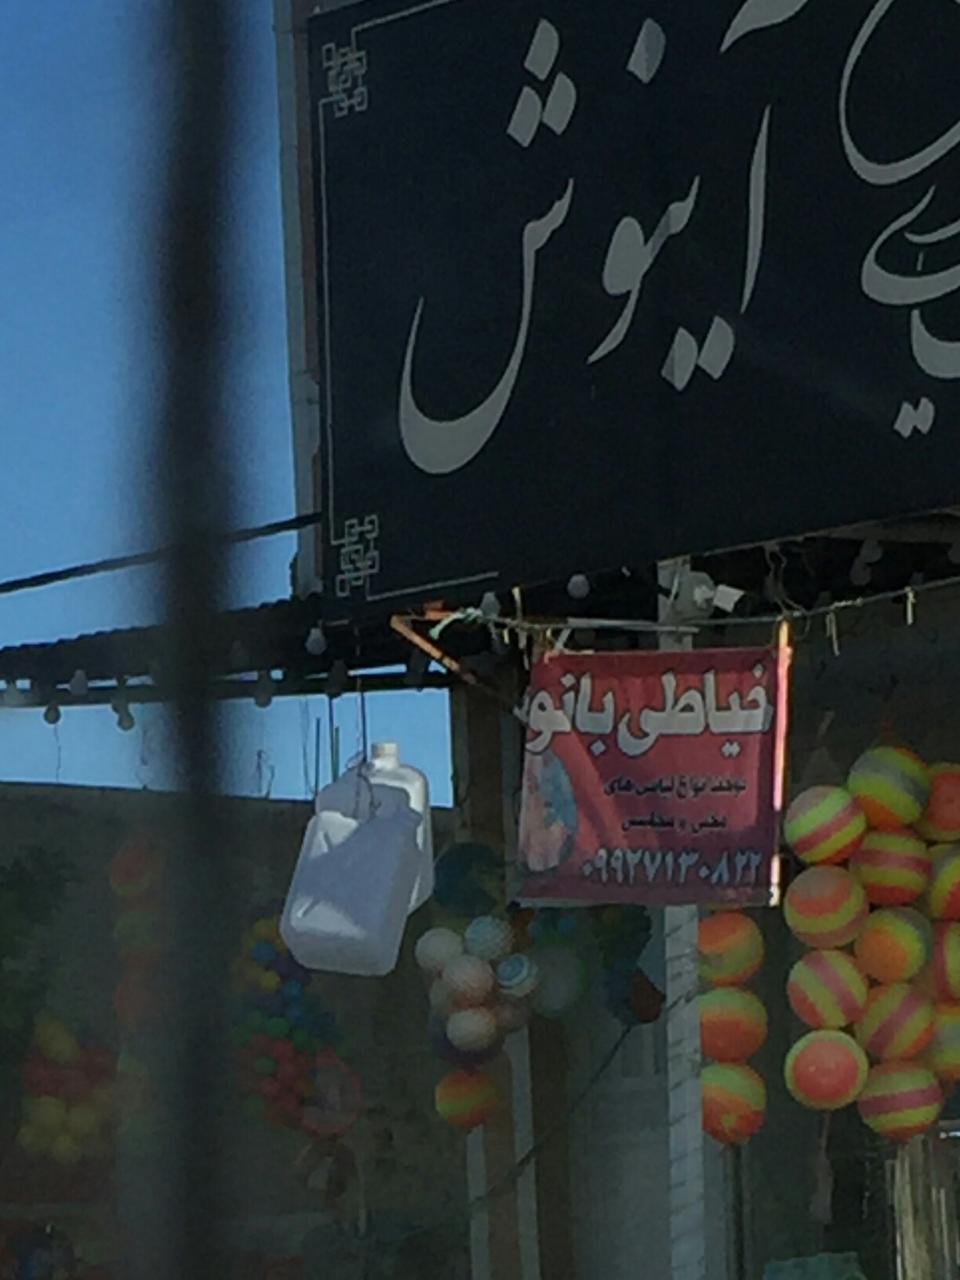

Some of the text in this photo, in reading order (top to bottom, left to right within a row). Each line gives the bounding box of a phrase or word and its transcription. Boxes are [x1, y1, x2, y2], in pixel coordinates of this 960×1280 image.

[513, 663, 773, 757] خیاطی بانو
[635, 776, 674, 799] لباس
